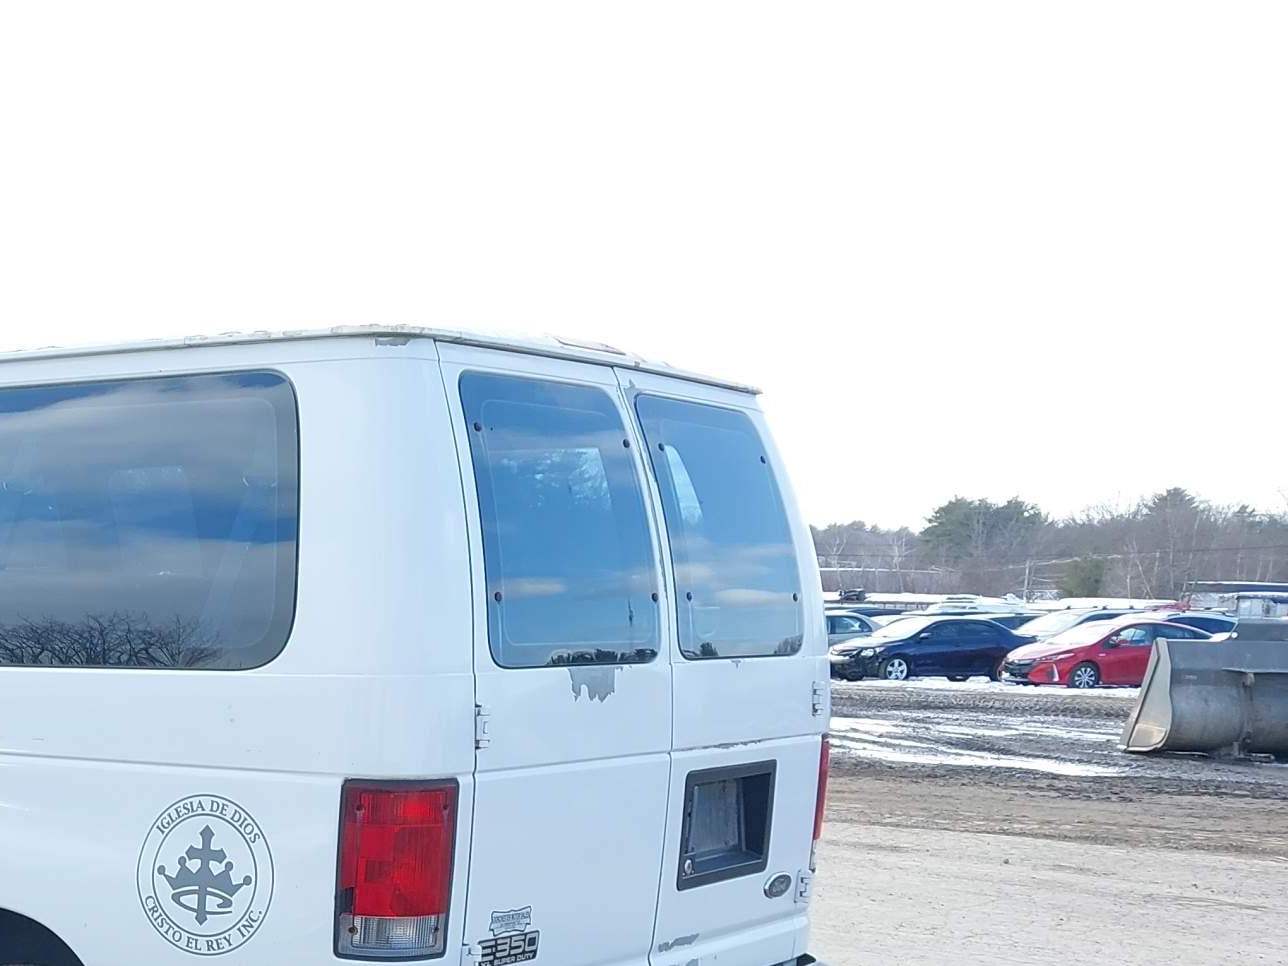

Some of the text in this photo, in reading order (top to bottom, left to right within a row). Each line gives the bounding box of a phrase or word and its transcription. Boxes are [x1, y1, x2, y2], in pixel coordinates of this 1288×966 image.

[155, 799, 261, 844] IGLESIA DE DIOS
[145, 895, 263, 952] CRISTO EL REY INC.
[516, 951, 535, 962] DUTY
